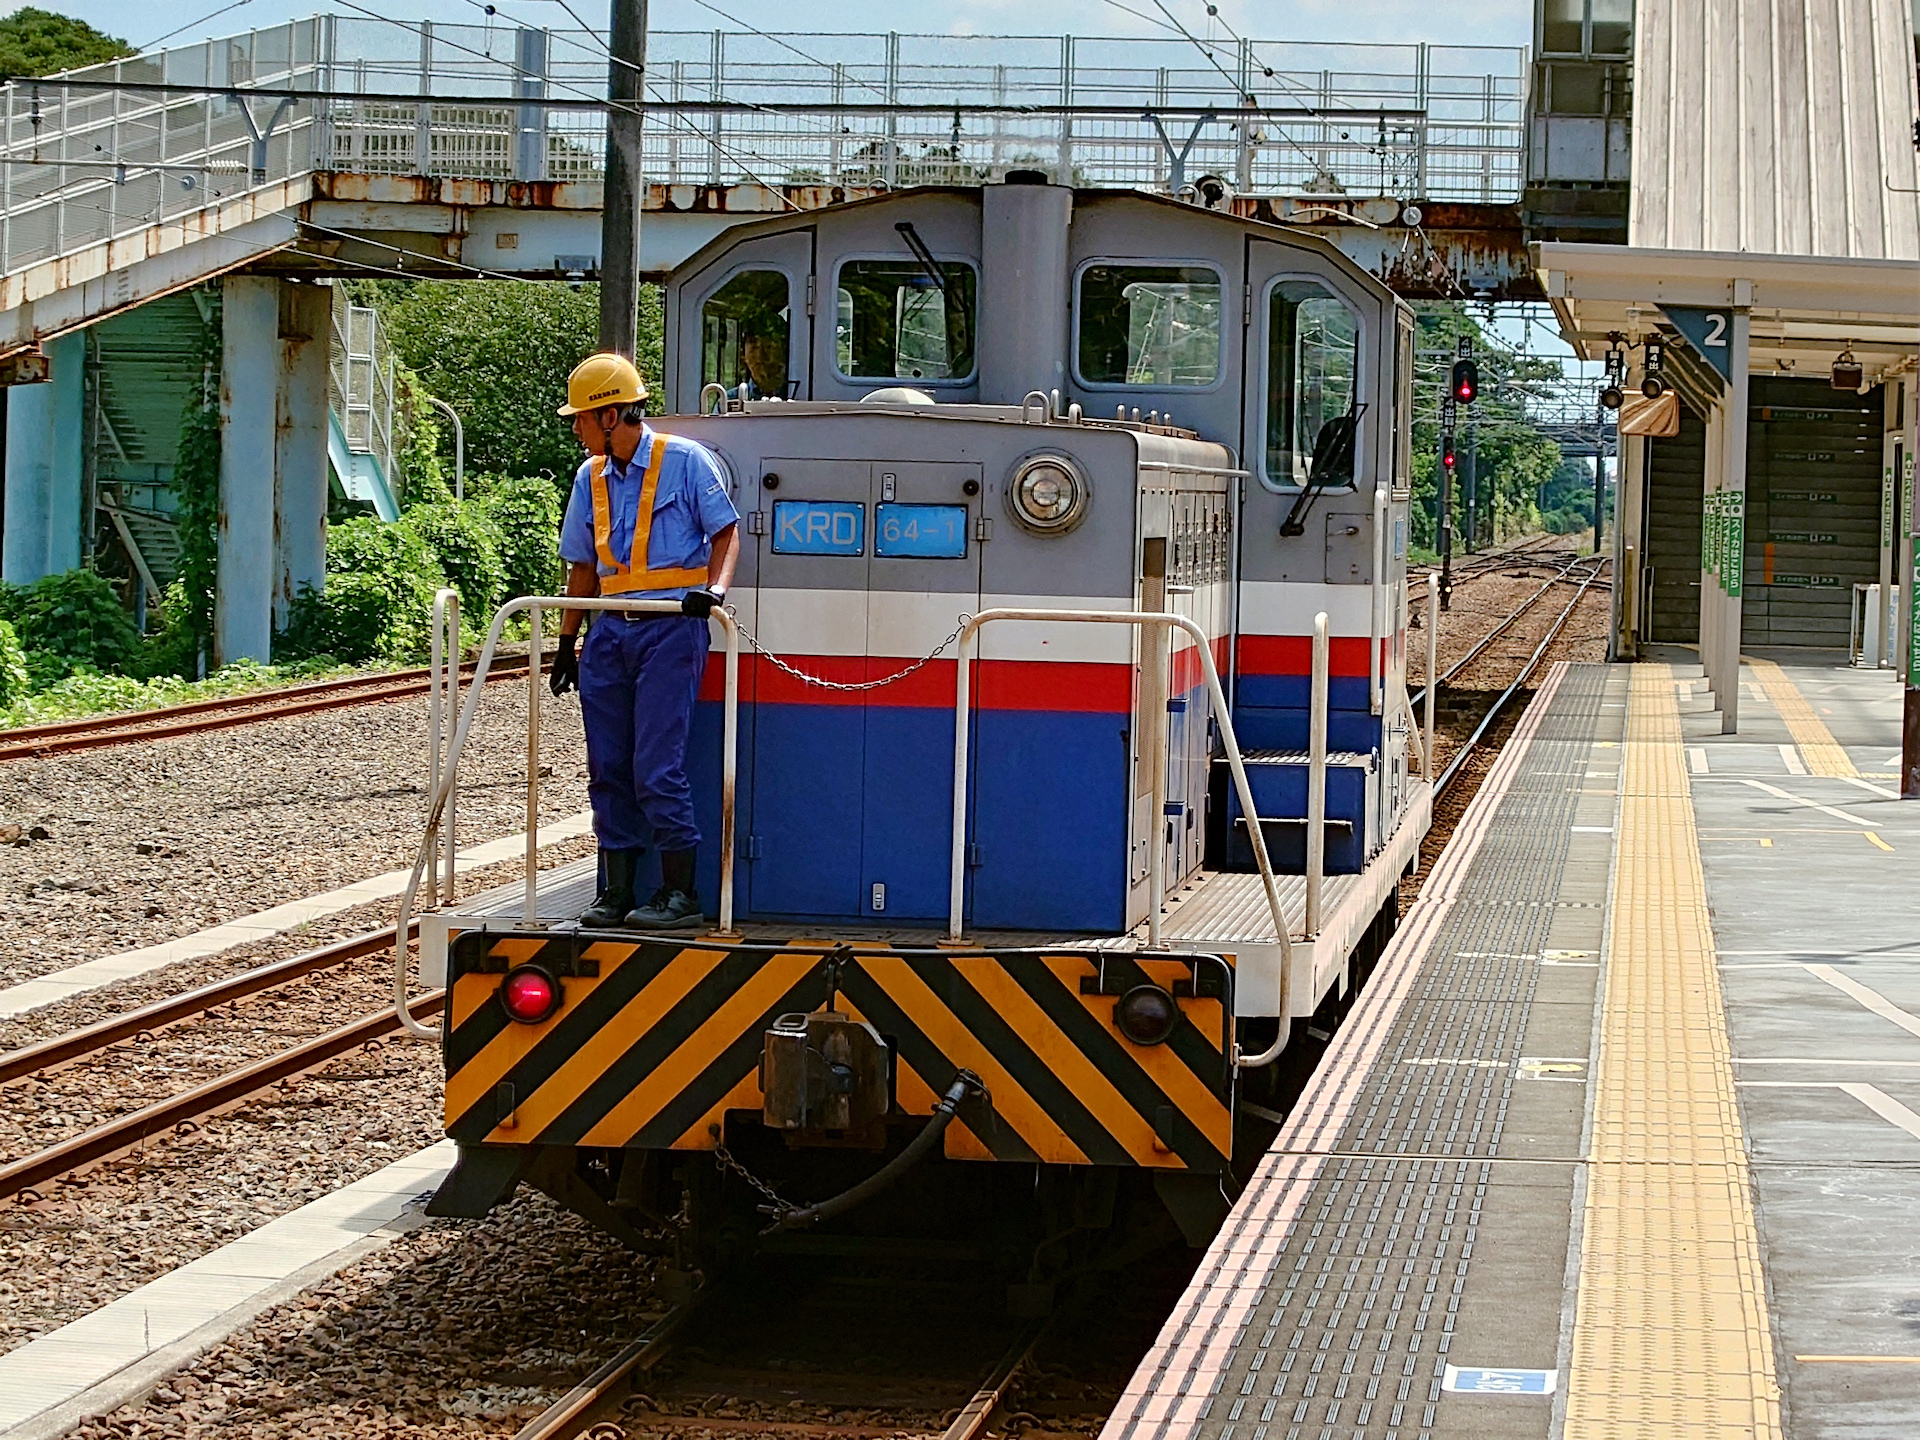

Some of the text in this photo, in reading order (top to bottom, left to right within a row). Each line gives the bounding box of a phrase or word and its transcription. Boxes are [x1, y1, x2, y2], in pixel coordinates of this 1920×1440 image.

[1704, 314, 1727, 347] 2
[780, 511, 954, 545] KRD 64-1
[1730, 518, 1741, 589] スイカはこちら
